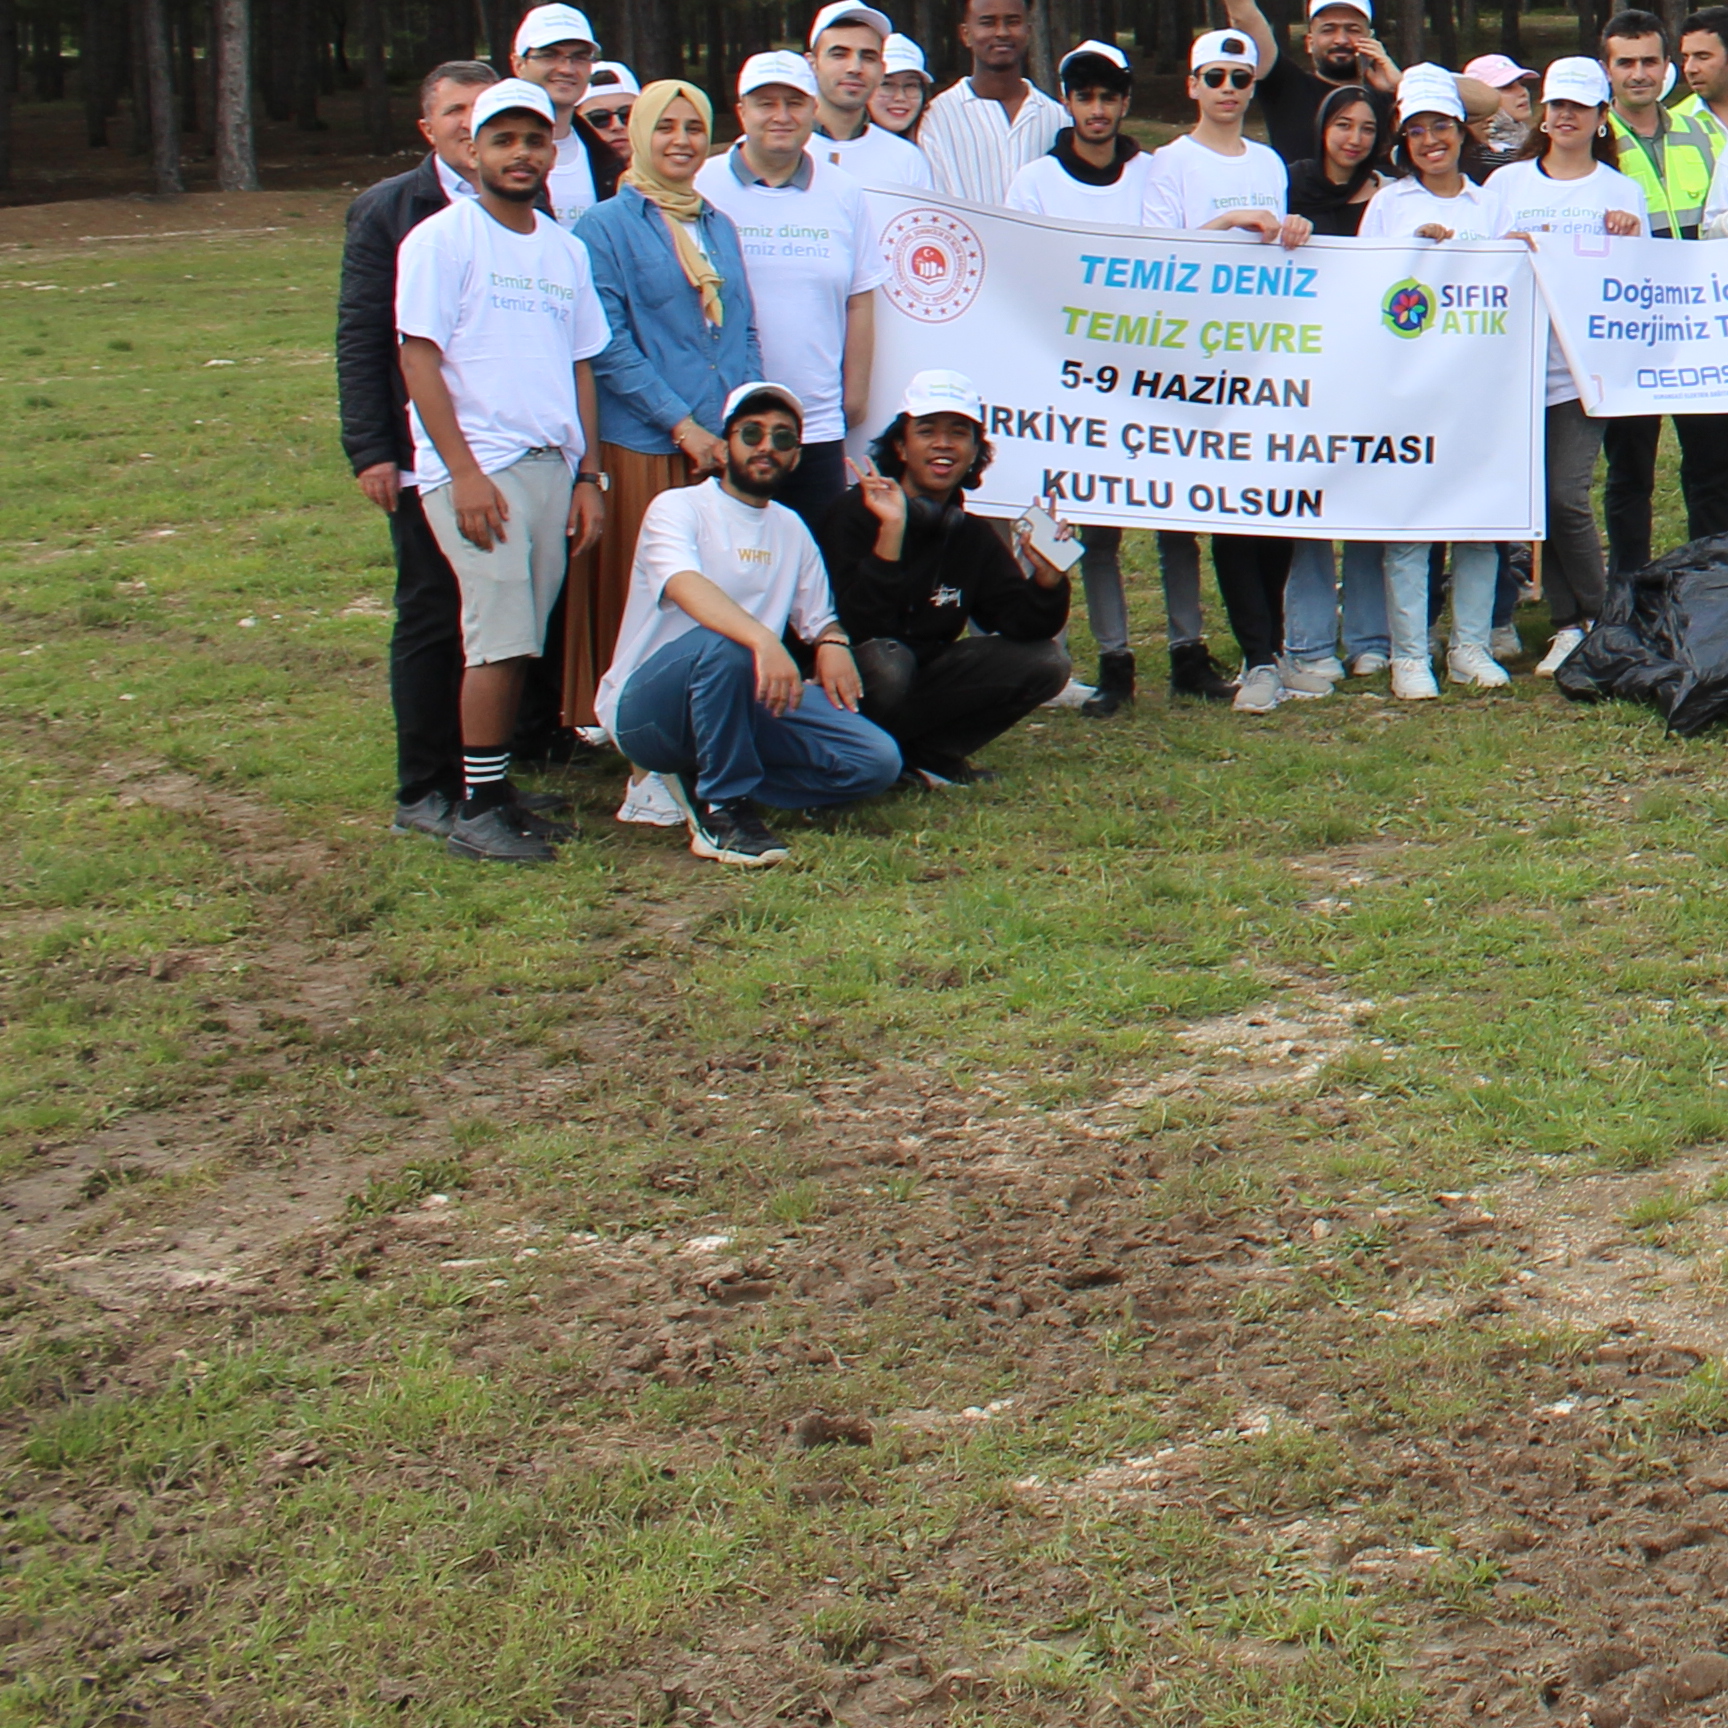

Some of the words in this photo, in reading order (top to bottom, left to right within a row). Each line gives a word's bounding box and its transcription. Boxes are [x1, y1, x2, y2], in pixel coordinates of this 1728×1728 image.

[737, 224, 773, 238] emiz
[779, 223, 829, 241] dünya
[744, 242, 775, 256] miz
[782, 241, 830, 259] deniz
[1080, 254, 1200, 293] TEMİZ
[1211, 259, 1318, 298] DENİZ
[1441, 285, 1508, 308] SIFIR
[1602, 278, 1706, 309] Doğamız
[1062, 306, 1189, 349] TEMİZ
[1200, 320, 1323, 359] ÇEVRE
[1441, 310, 1509, 335] ATIK
[1588, 314, 1710, 347] Enerjimiz
[1061, 359, 1119, 393] 5-9
[1131, 369, 1311, 407] HAZİRAN
[1121, 423, 1252, 460] ÇEVRE
[1266, 433, 1435, 464] HAFTASI
[1043, 468, 1173, 509] KUTLU
[1188, 483, 1324, 518] OLSUN
